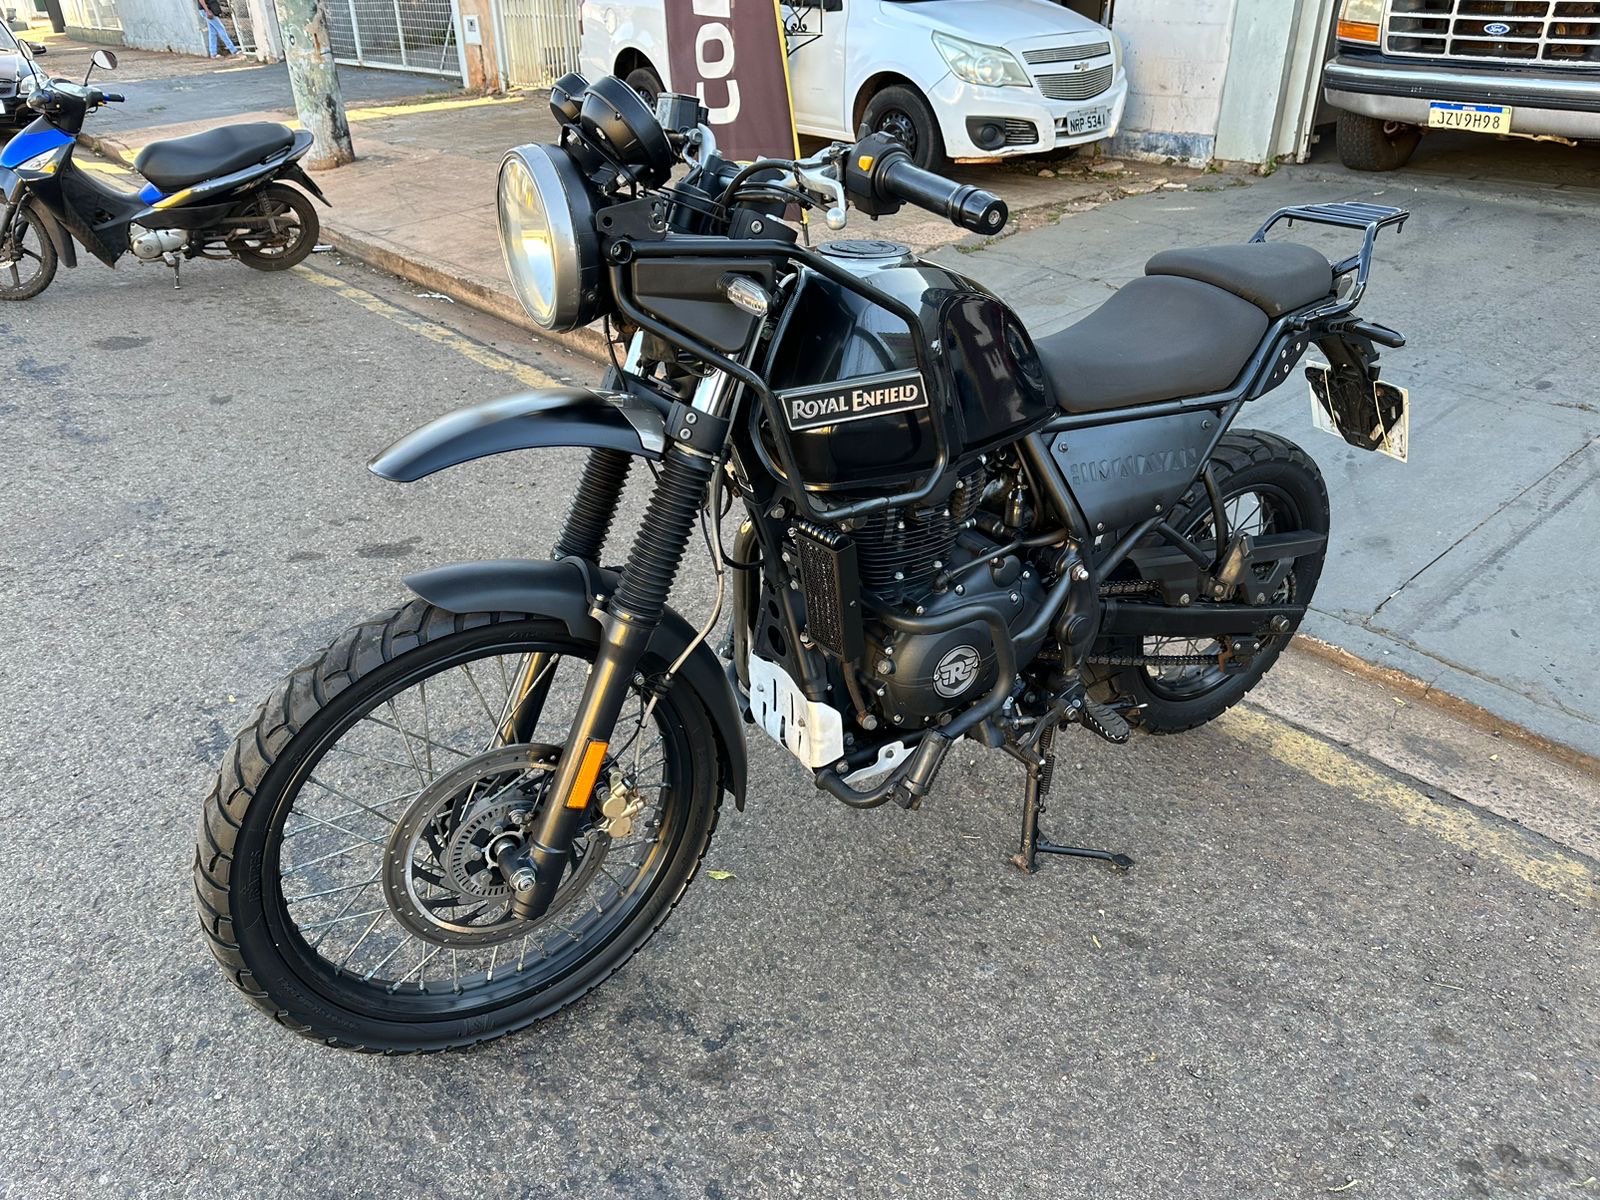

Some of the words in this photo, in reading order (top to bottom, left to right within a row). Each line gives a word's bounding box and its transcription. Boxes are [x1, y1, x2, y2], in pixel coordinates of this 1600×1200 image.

[1437, 111, 1500, 130] JZV9H98
[792, 396, 849, 420] ROYAL
[852, 384, 919, 412] ENFIELD
[1070, 447, 1197, 485] HIMALAYAN
